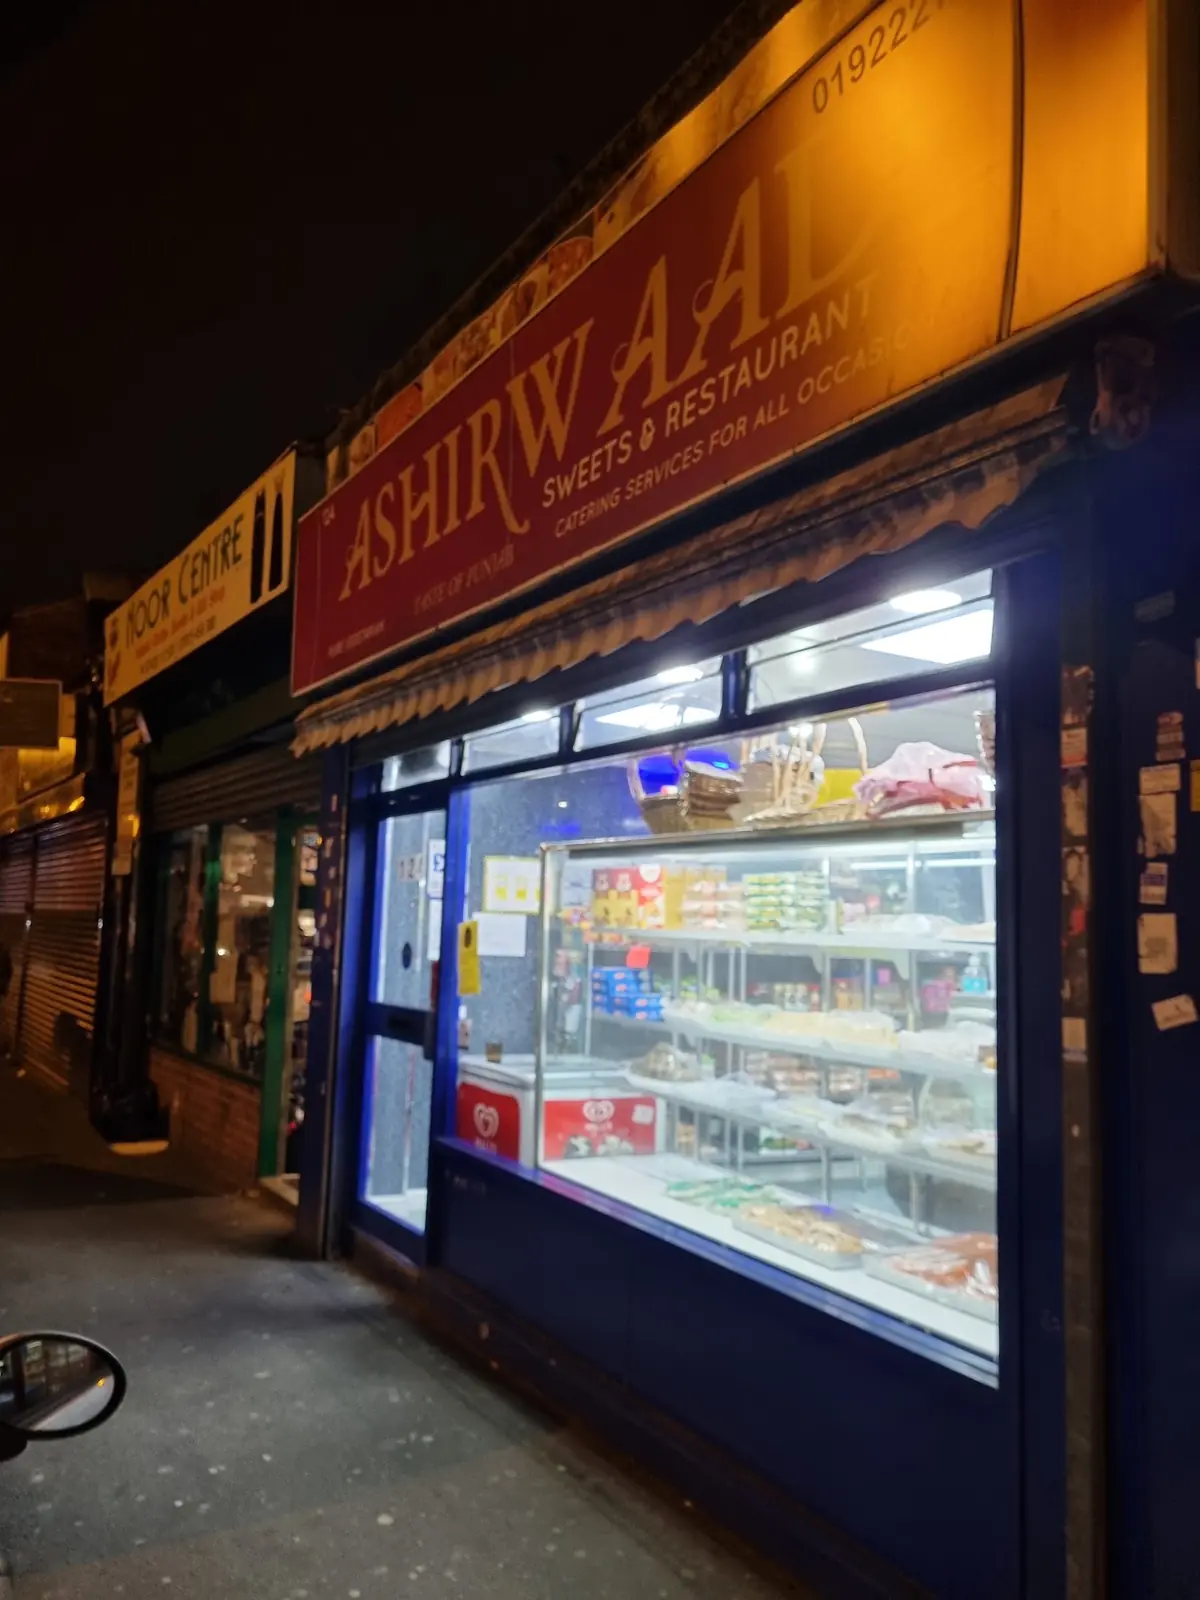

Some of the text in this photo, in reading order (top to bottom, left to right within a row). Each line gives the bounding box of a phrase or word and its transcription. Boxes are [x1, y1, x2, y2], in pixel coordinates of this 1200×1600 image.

[812, 0, 946, 115] 019222
[542, 431, 632, 508] SWEETS
[665, 270, 880, 437] RESTAURANT
[554, 485, 621, 540] CATERING
[625, 440, 704, 502] SERVICES
[709, 417, 747, 456] FOR
[753, 392, 790, 432] ALL
[125, 577, 171, 651] NOOR
[178, 511, 245, 605] CENTRE
